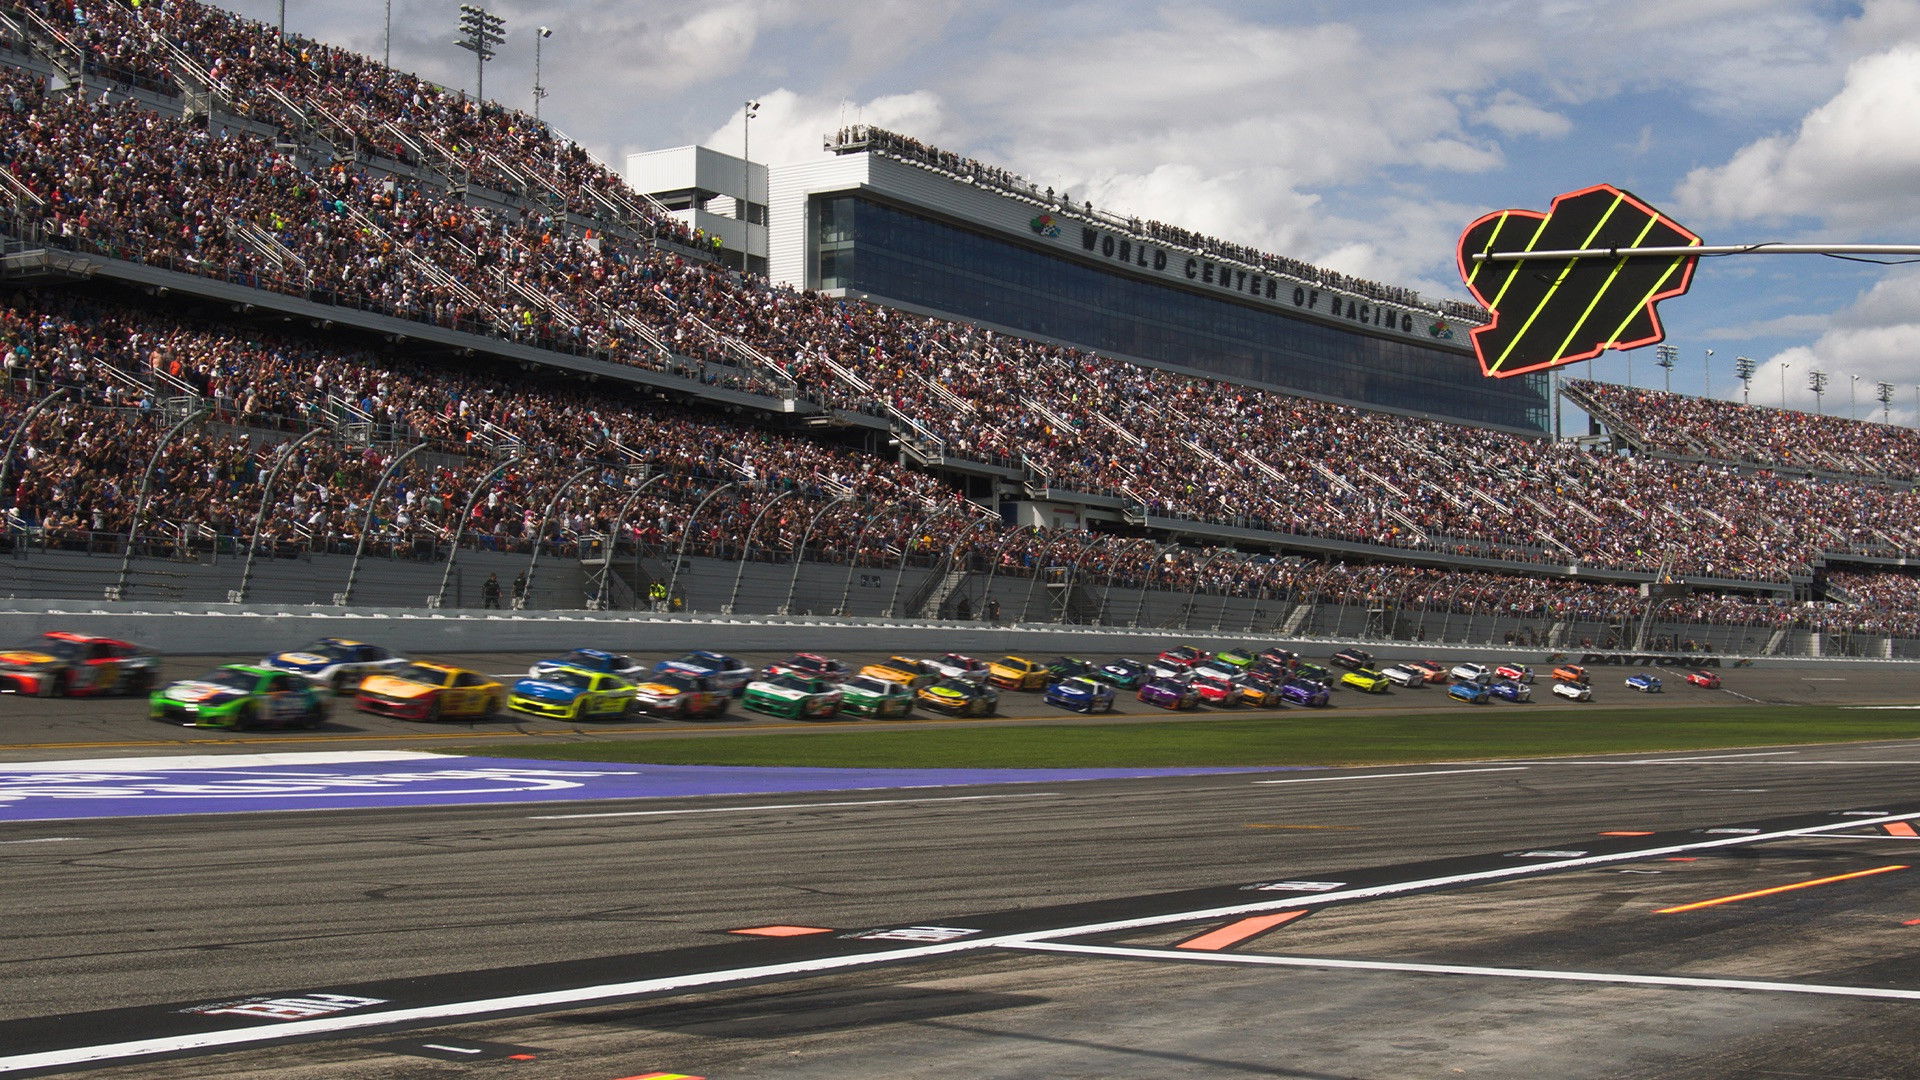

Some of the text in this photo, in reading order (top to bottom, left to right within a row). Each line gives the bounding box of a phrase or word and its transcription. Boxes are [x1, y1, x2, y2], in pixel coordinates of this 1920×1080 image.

[1082, 227, 1412, 333] WORLD CENTER OF RACING
[1579, 654, 1721, 668] DAYTONA
